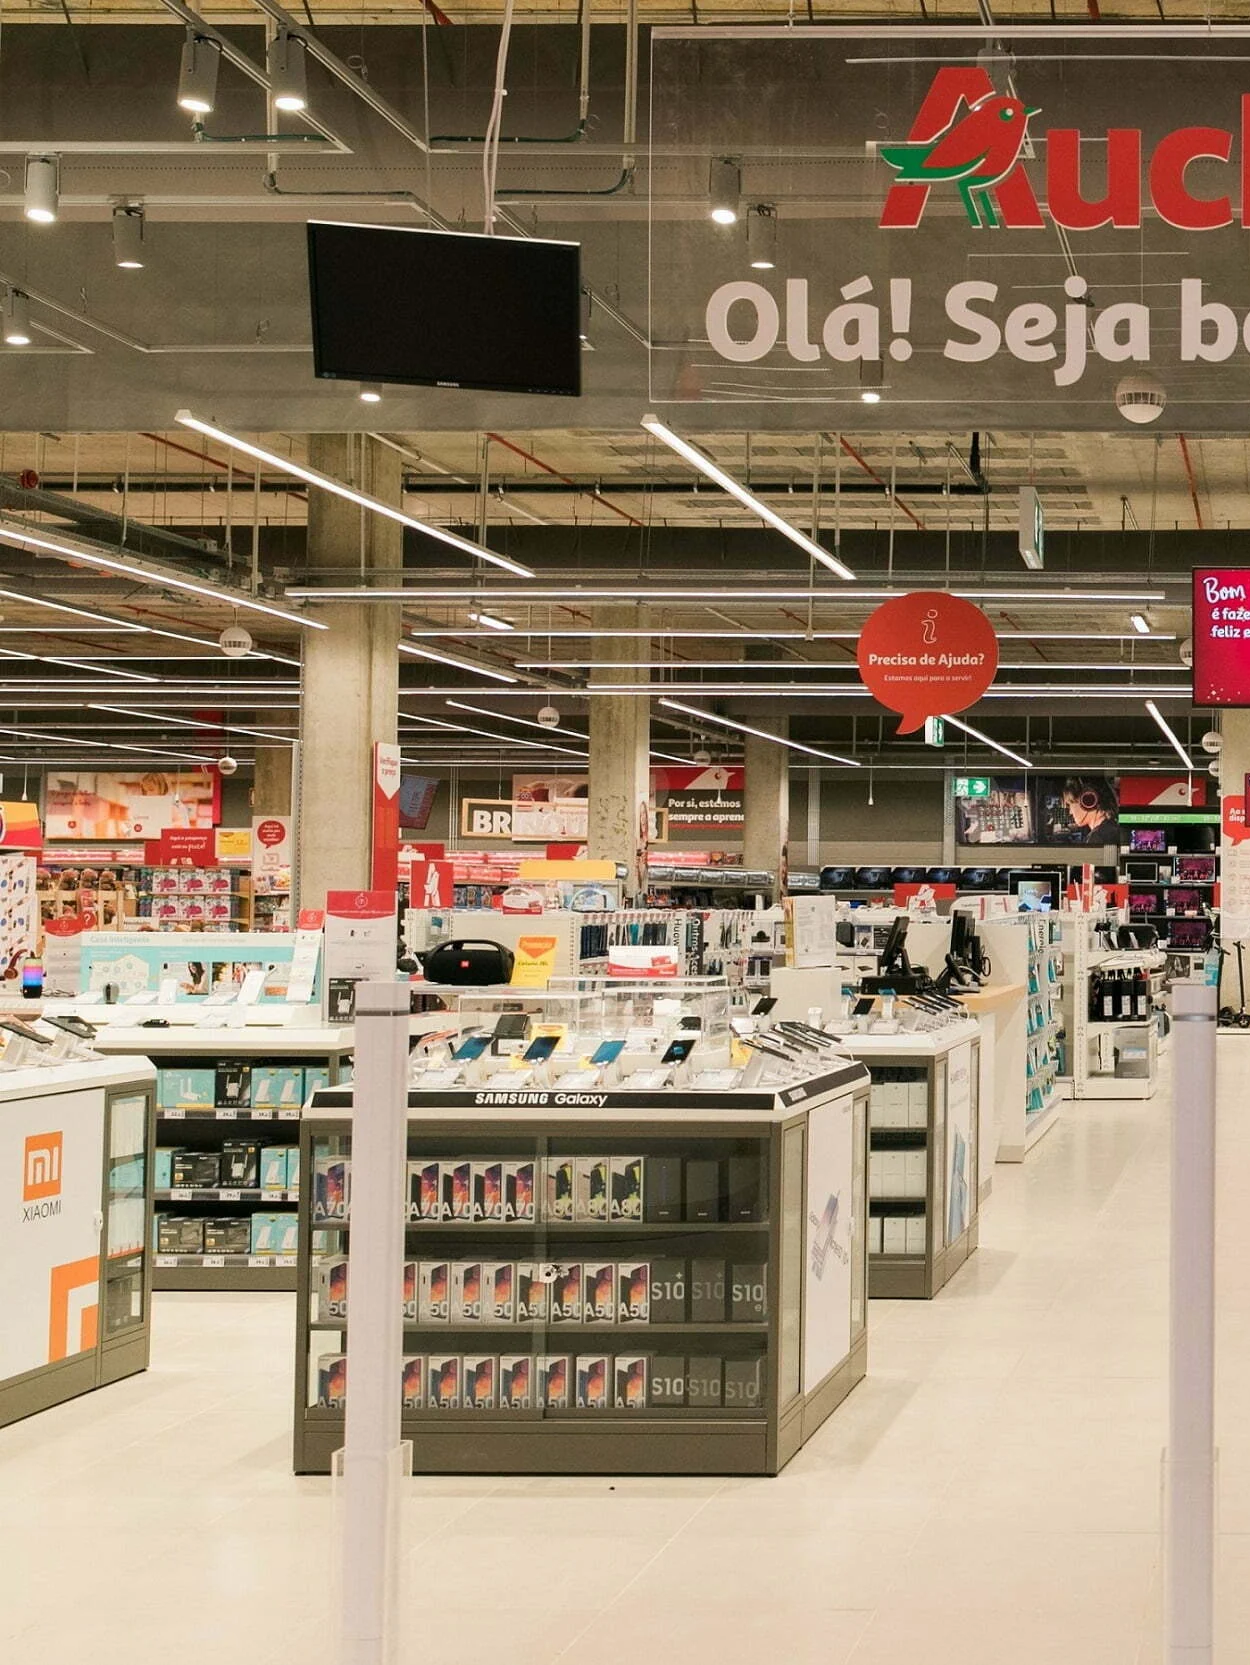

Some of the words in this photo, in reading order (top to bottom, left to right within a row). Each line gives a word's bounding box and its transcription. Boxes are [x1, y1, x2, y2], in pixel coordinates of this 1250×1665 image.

[704, 277, 911, 363] Olá!
[943, 277, 1153, 387] Seja
[1203, 577, 1246, 604] Bom
[1212, 608, 1220, 620] é
[1211, 625, 1240, 638] feliz
[869, 654, 916, 666] Precisa
[919, 653, 936, 666] de
[938, 653, 985, 667] Ajuda?
[668, 799, 687, 808] Por
[699, 799, 741, 808] estamos
[668, 813, 704, 825] sempre
[475, 1092, 549, 1105] SAMSUNG
[554, 1092, 608, 1108] Galaxy
[22, 1200, 62, 1223] XIAOMI
[732, 1284, 765, 1302] S10
[652, 1377, 684, 1396] S10
[689, 1379, 720, 1397] S10
